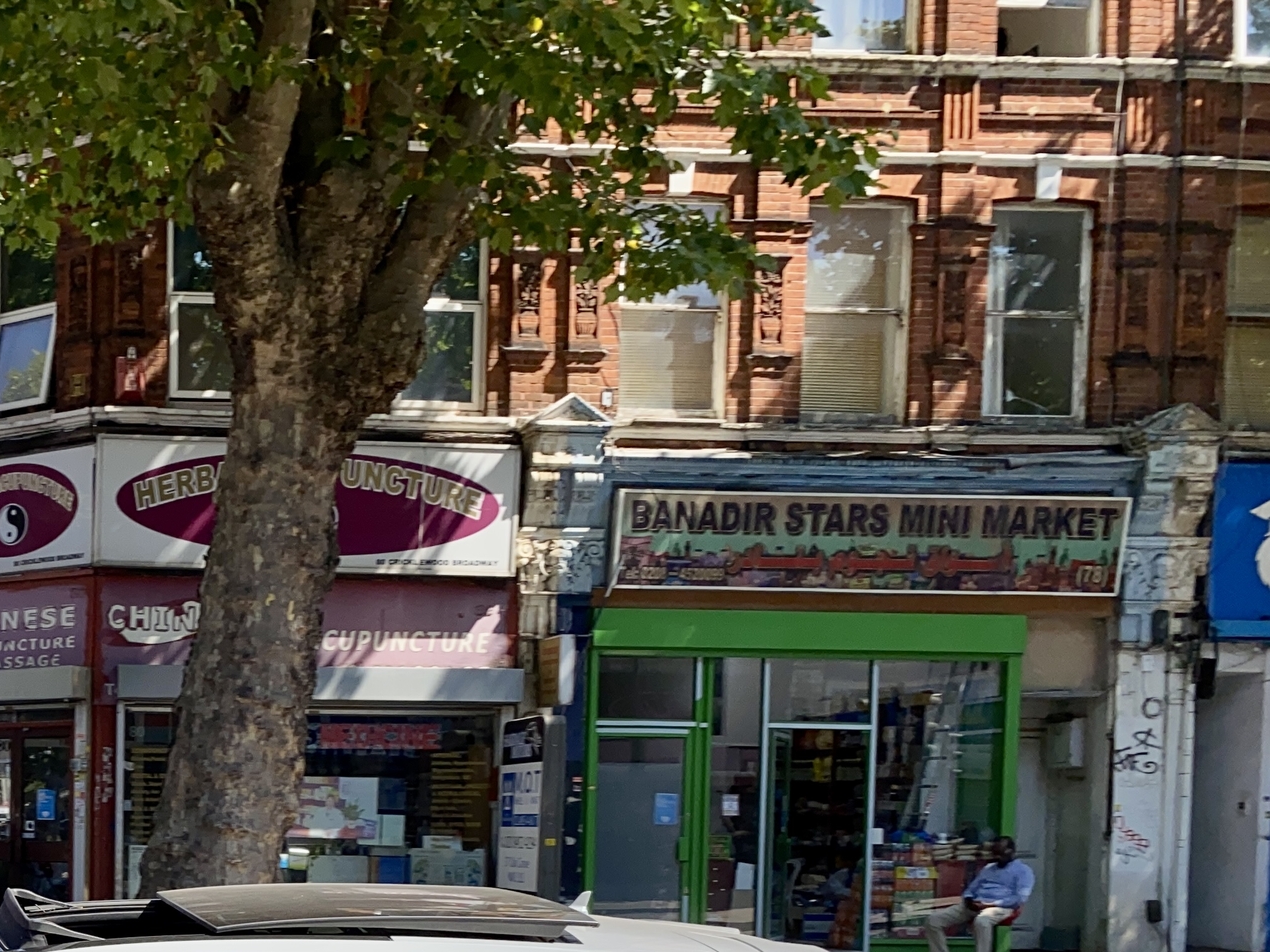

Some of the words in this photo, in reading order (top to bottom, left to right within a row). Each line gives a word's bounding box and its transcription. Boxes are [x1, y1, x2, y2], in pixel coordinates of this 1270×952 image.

[133, 462, 224, 511] HERB
[340, 458, 486, 520] UNCTURE
[631, 500, 776, 535] BANADIR
[785, 503, 889, 537] STARS
[898, 504, 971, 537] MINI
[981, 506, 1119, 540] MARKET
[108, 601, 201, 631] CHIN
[315, 629, 491, 654] CUPUNCTURE
